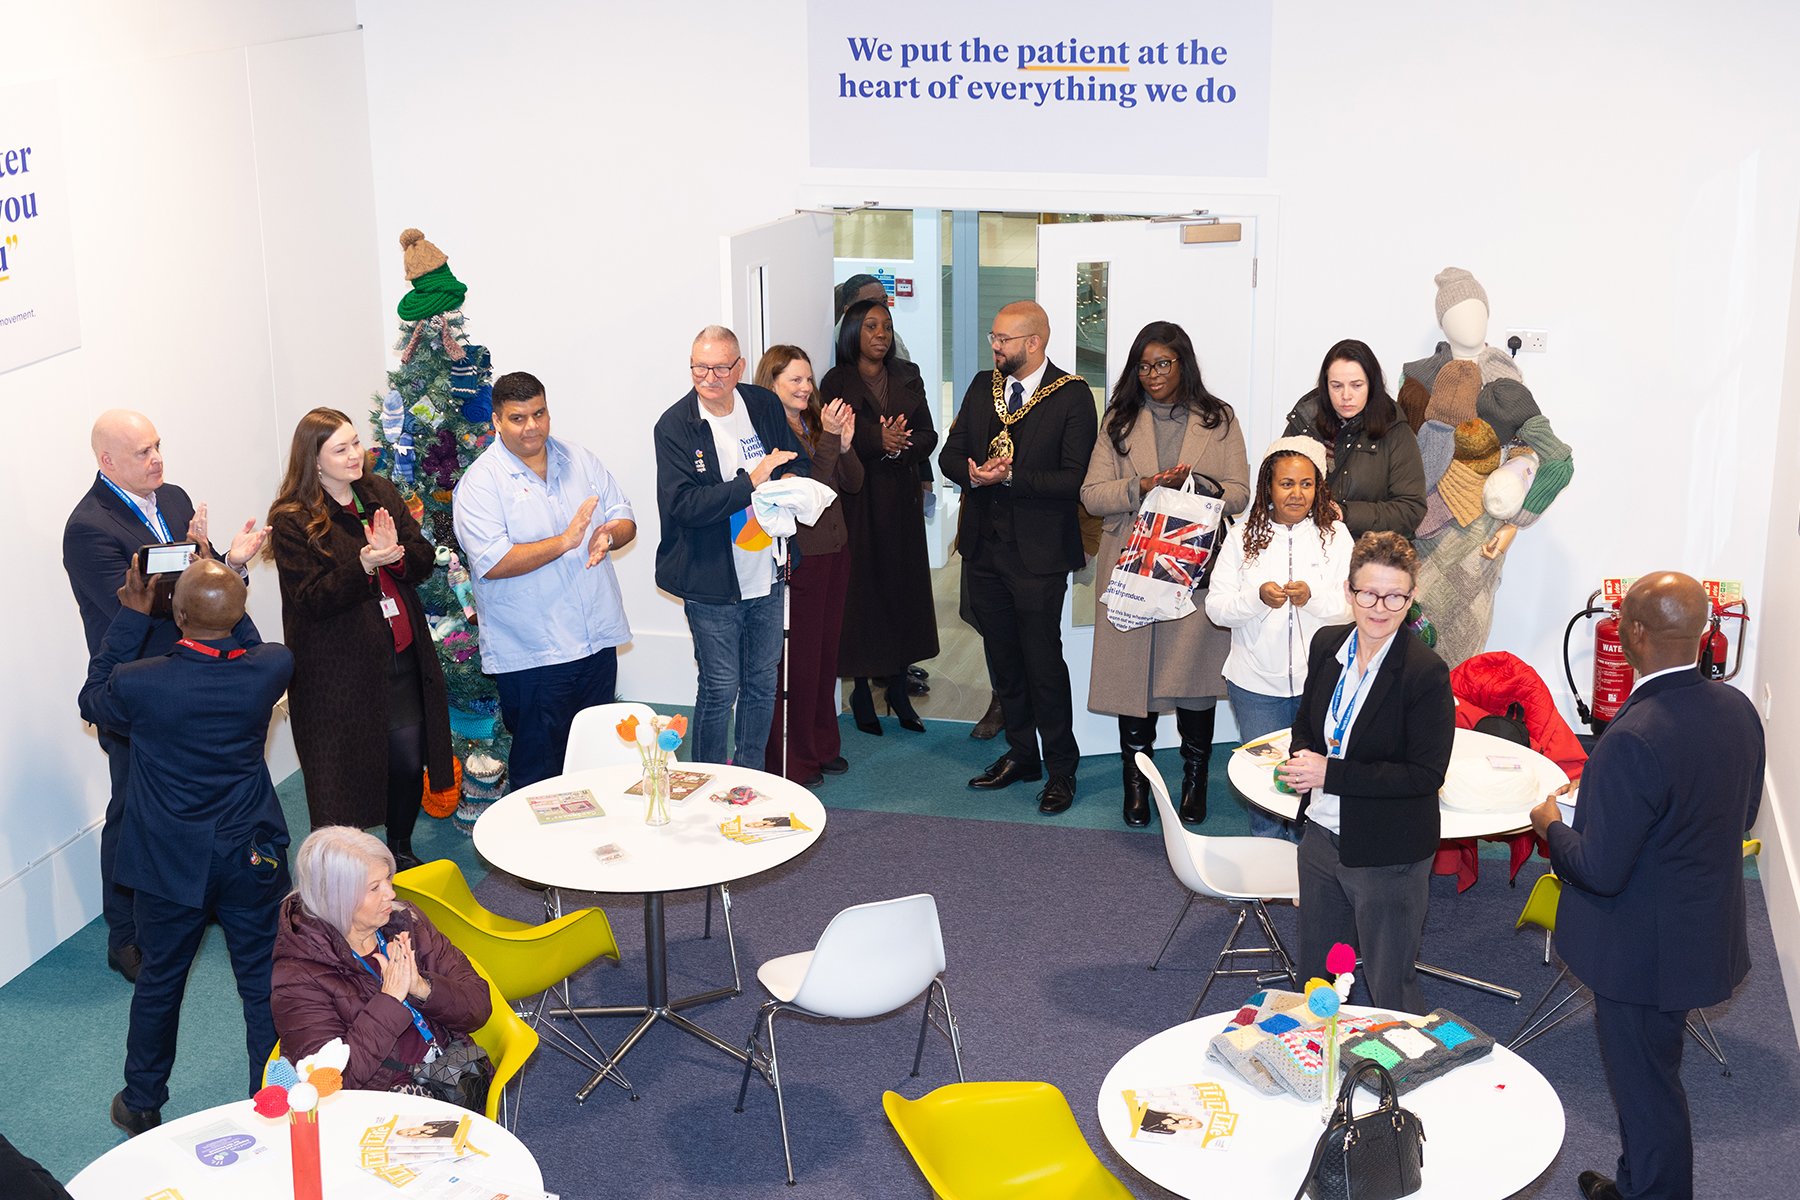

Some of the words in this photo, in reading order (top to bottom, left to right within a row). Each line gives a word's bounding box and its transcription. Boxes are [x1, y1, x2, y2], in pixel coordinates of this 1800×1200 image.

[847, 36, 893, 62] We
[900, 40, 952, 68] put
[960, 36, 1009, 64] the
[1017, 38, 1129, 69] patient
[1137, 42, 1169, 65] at
[1176, 38, 1228, 66] the
[839, 73, 920, 99] heart
[927, 74, 964, 100] of
[967, 75, 1137, 109] everything
[1145, 83, 1188, 103] we
[1195, 76, 1237, 104] do
[1602, 643, 1624, 653] WATE
